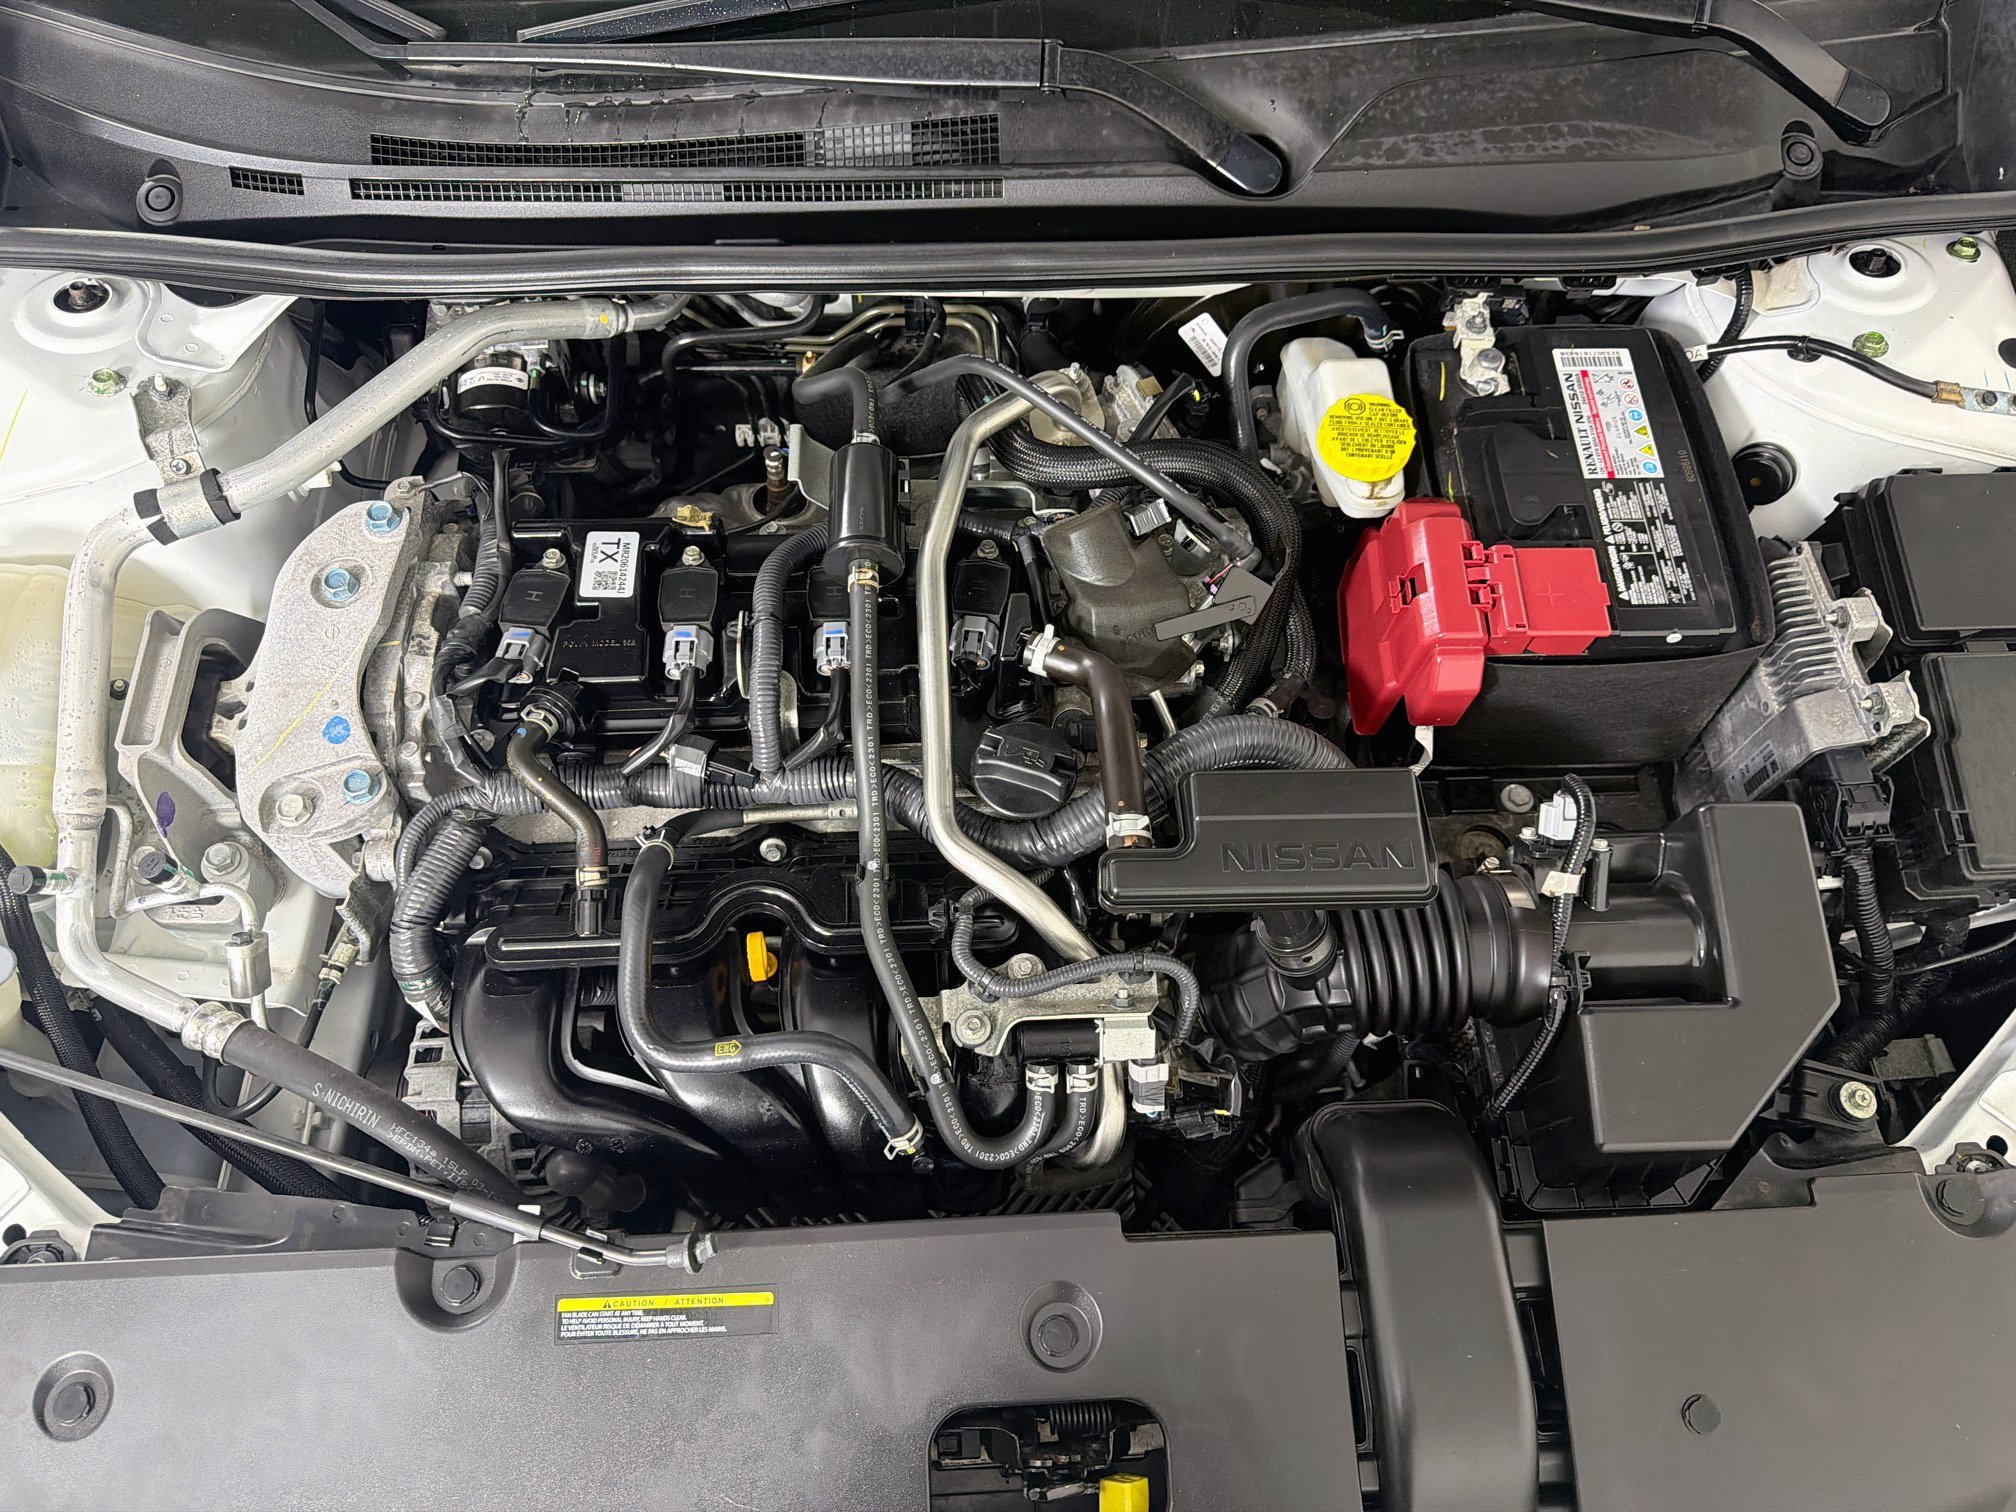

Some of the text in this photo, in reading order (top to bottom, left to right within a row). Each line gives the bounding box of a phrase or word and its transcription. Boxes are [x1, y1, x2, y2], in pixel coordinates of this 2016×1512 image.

[1562, 373, 1599, 474] RENAULT NISSAN
[598, 538, 620, 563] TX
[864, 599, 873, 660] TRD>ECO<2301
[865, 664, 874, 731] TRD>ECO<2301
[868, 735, 880, 808] TRD>ECO<2301
[1220, 841, 1416, 872] NISSAN
[391, 1123, 439, 1157] HFC134a
[442, 1157, 469, 1178] 15LP
[613, 1299, 654, 1307] CAUTION
[674, 1297, 724, 1305] ATTENTION
